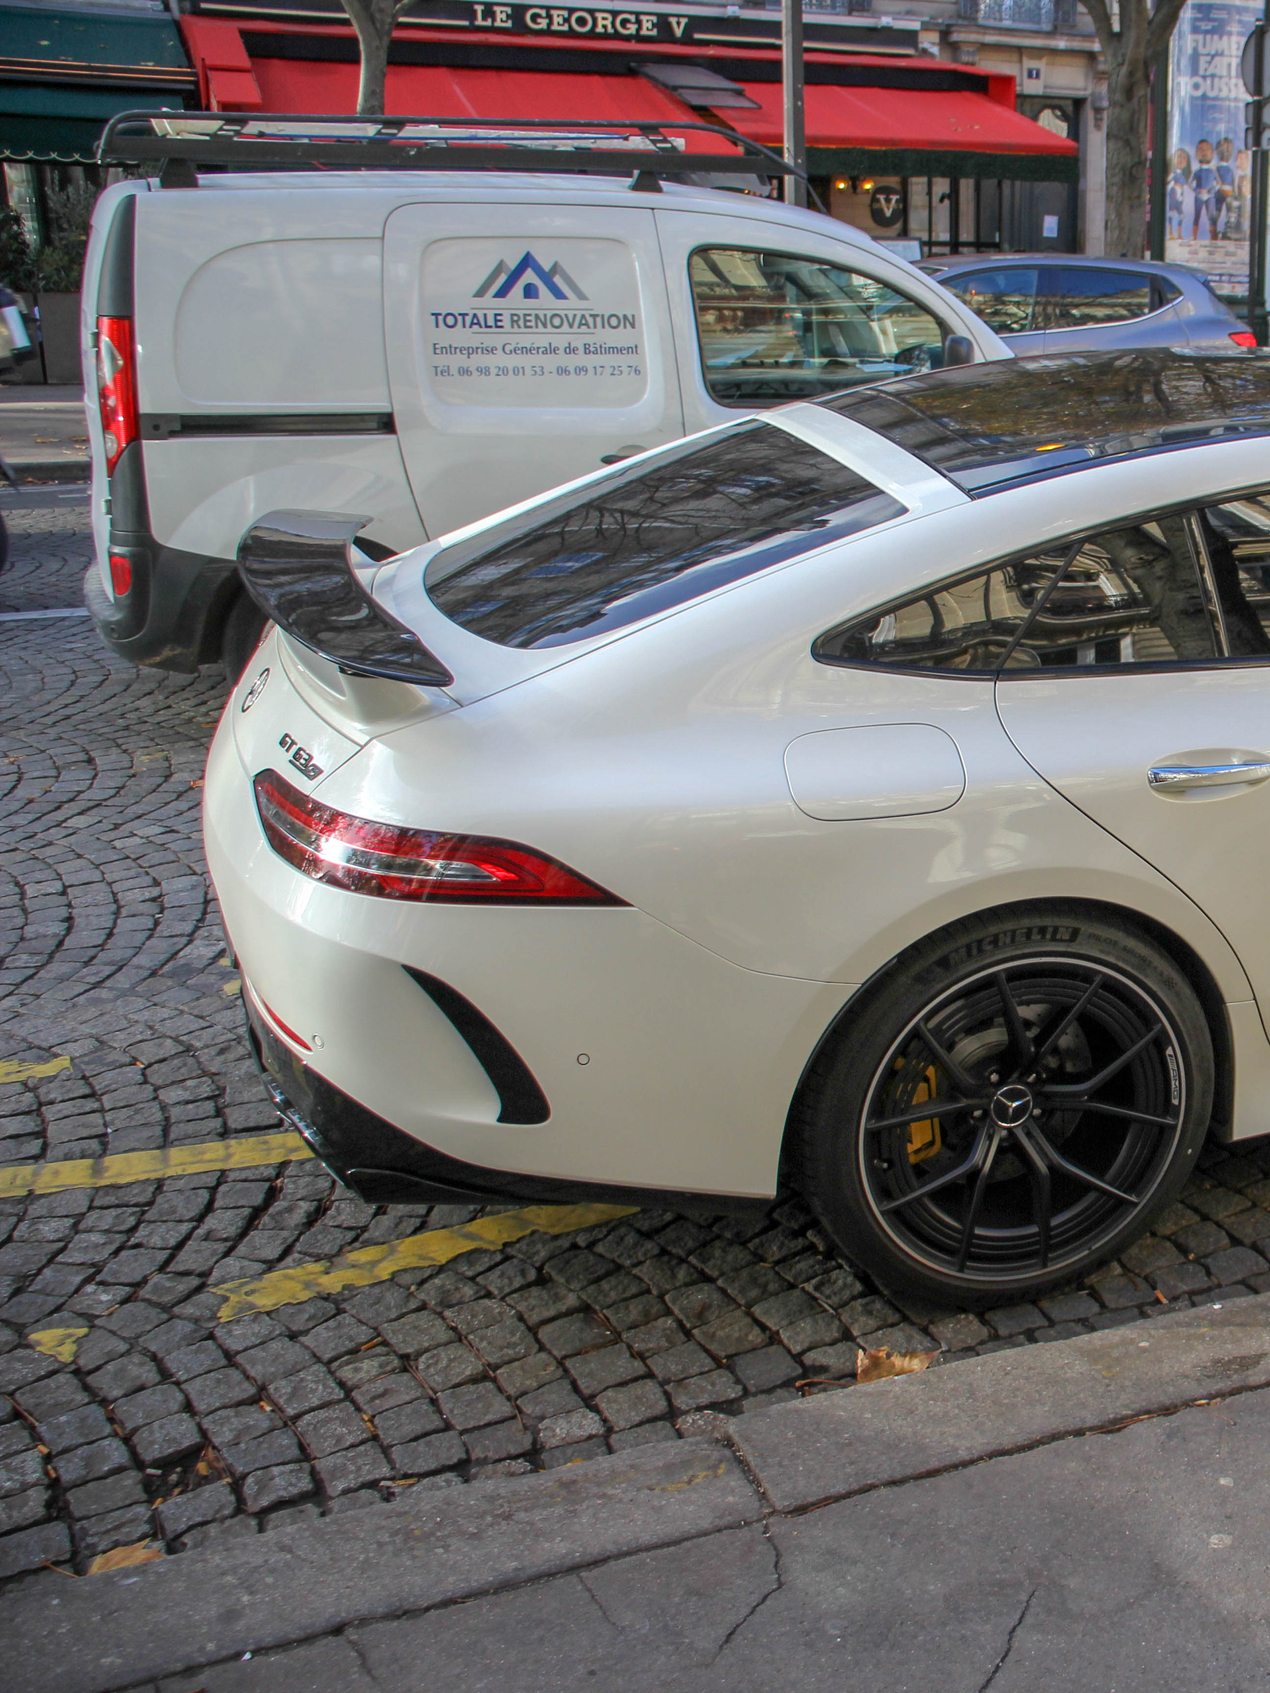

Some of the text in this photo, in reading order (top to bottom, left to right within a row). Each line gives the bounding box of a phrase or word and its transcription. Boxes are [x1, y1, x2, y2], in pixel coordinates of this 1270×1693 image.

[473, 4, 688, 38] LE GEORGE V
[1199, 55, 1241, 76] FAIT
[875, 193, 900, 218] V
[430, 312, 636, 330] TOTALE RENOVATION
[432, 342, 640, 359] Entreprise Générale de Bâtiment
[432, 365, 455, 377] Tél.
[458, 366, 473, 377] 06
[476, 366, 491, 377] 98
[495, 366, 509, 377] 20
[513, 366, 527, 377] 01
[531, 366, 545, 377] 53
[556, 366, 571, 377] 06
[574, 366, 589, 377] 09
[593, 366, 605, 376] 17
[609, 366, 623, 376] 25
[627, 366, 641, 376] 76
[279, 733, 298, 753] GT
[950, 926, 1075, 964] MICHELIN
